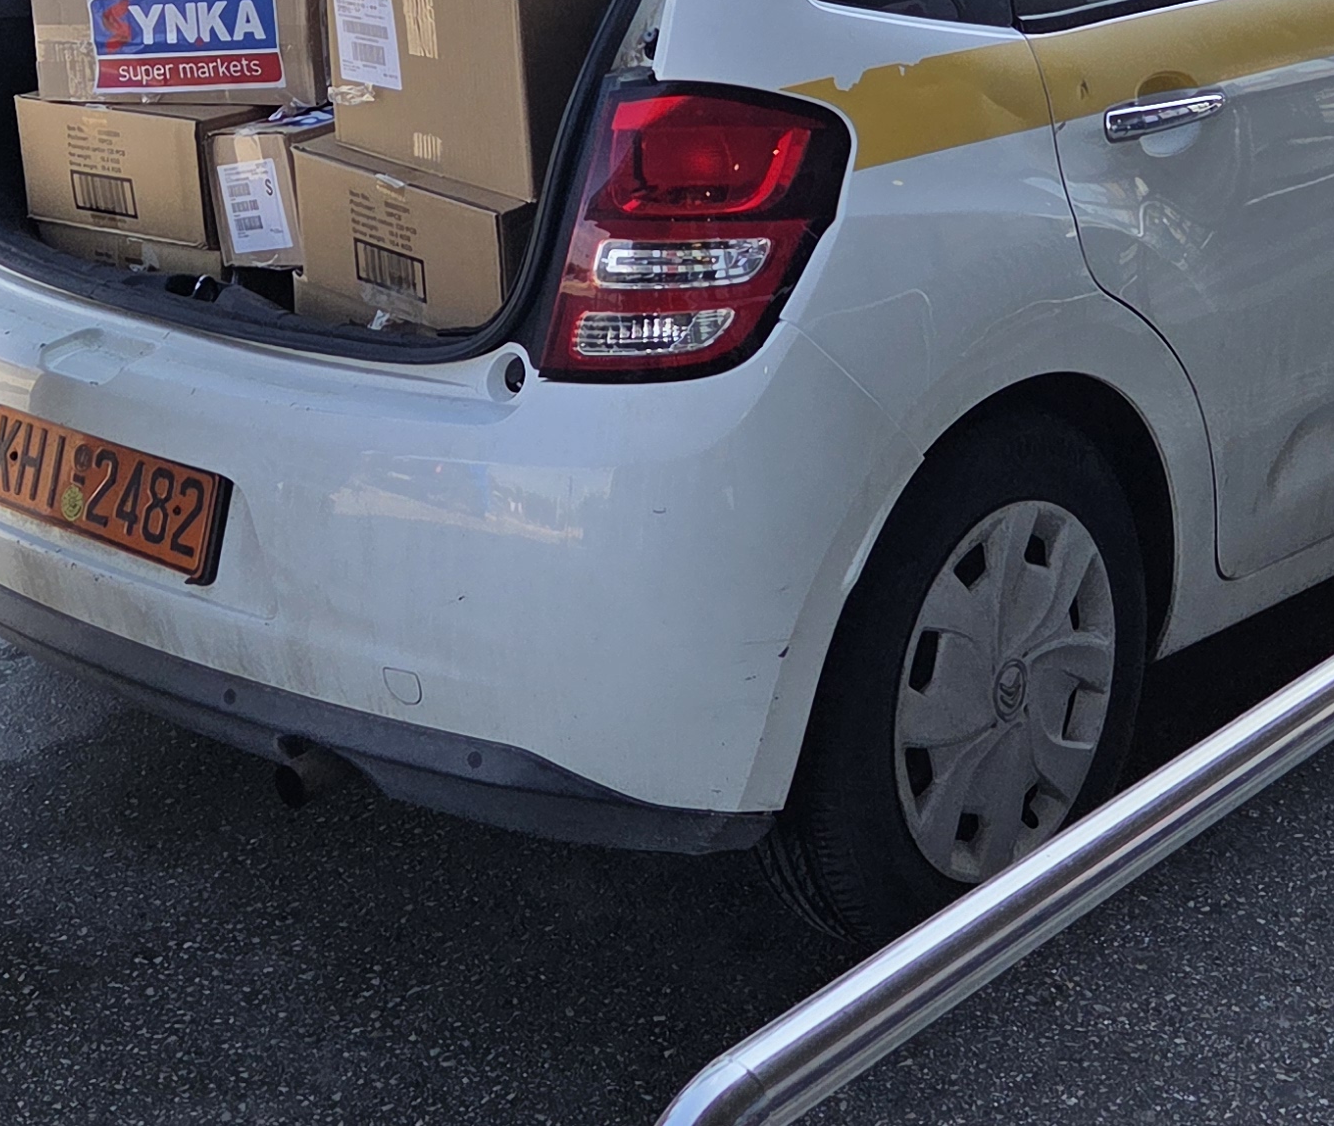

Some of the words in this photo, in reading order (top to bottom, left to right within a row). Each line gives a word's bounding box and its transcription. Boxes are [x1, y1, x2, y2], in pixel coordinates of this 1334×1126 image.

[118, 61, 174, 85] super
[179, 57, 262, 79] markets
[264, 178, 274, 196] S
